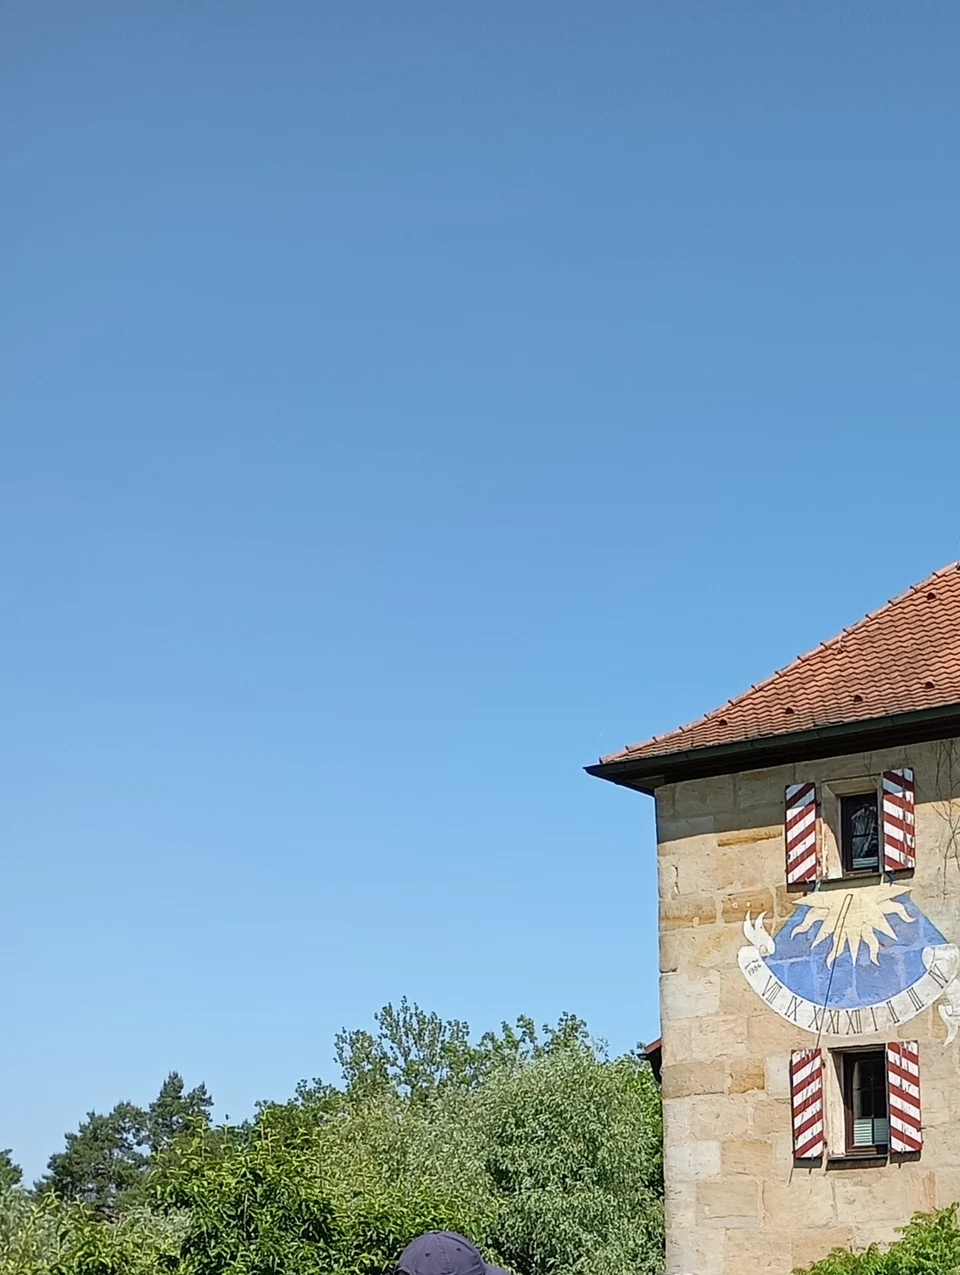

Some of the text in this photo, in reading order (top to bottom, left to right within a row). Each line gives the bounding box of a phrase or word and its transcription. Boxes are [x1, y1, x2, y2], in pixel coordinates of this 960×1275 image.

[762, 963, 949, 1035] VIII IX X XI XII I II III IV
